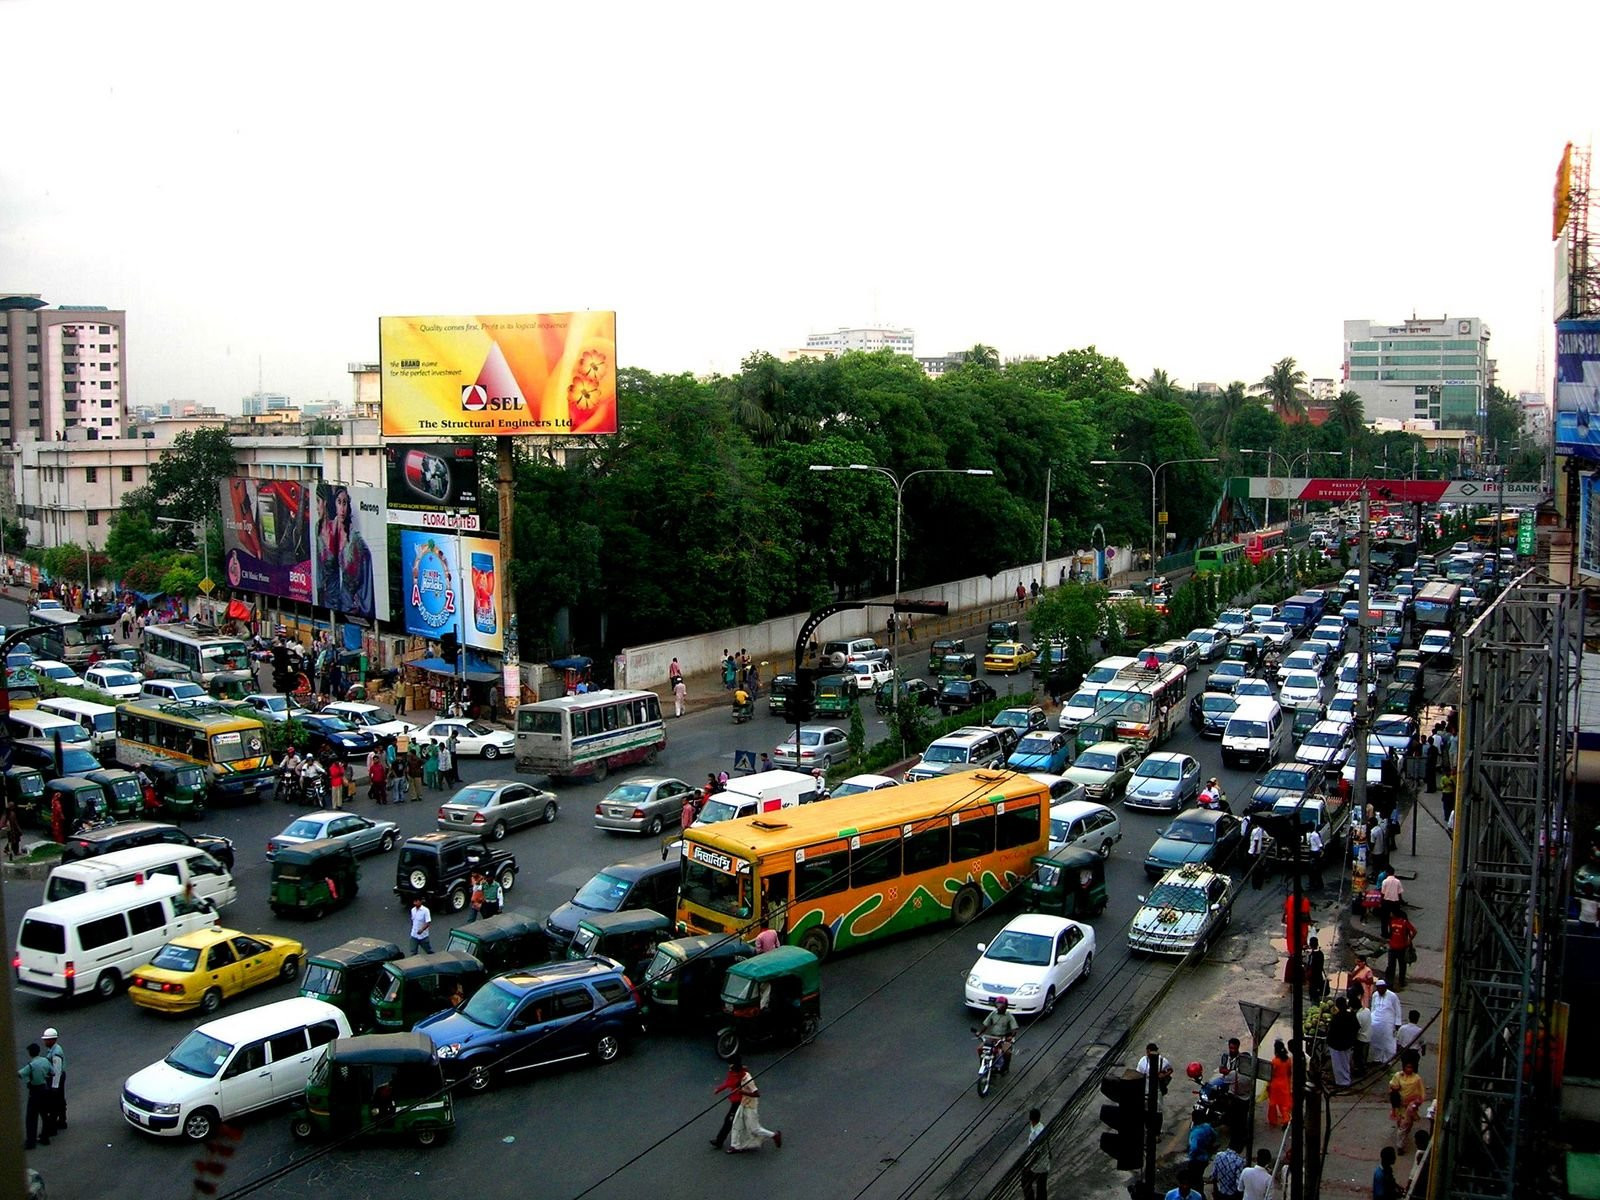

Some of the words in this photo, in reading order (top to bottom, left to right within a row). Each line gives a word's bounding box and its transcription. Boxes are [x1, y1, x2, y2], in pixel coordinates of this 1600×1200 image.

[420, 324, 442, 332] Quality
[516, 322, 536, 331] logical
[401, 360, 420, 368] BRAND
[410, 370, 431, 378] perfect
[490, 397, 523, 411] SEL
[419, 419, 438, 428] The
[442, 419, 494, 428] Structural
[499, 418, 551, 429] Engineers
[1508, 484, 1538, 492] BANK
[360, 501, 380, 515] Aarong
[423, 513, 446, 526] FLORA
[289, 571, 307, 586] BenQ
